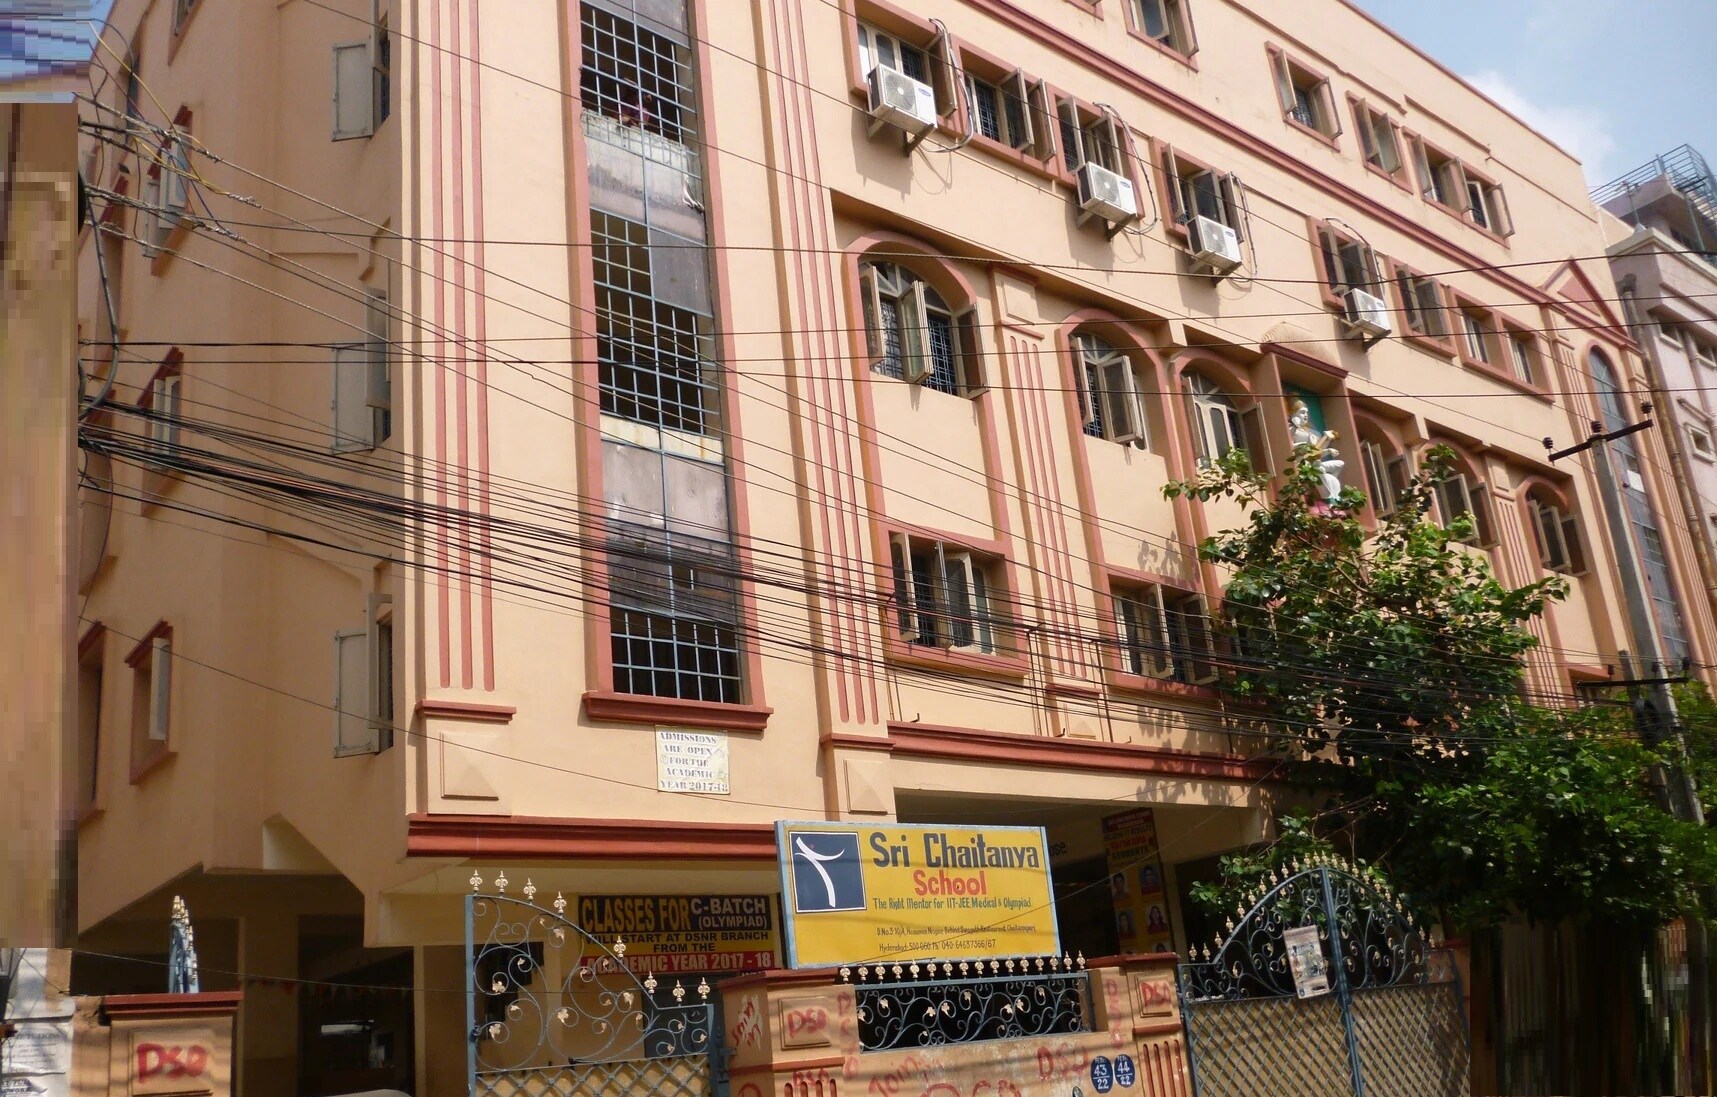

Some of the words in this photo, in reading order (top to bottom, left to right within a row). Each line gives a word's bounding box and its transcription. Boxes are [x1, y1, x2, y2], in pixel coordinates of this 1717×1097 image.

[660, 732, 717, 744] ADMISSIONS
[664, 745, 683, 753] ARE
[687, 746, 713, 756] OPEN
[669, 757, 688, 766] FOR
[667, 768, 713, 779] ACADEMIC
[660, 781, 687, 789] YEAR
[869, 831, 910, 868] Sri
[923, 832, 1040, 869] Chaitanya
[913, 869, 987, 896] School
[873, 897, 888, 910] The
[888, 897, 905, 910] Right
[907, 897, 932, 909] Mentor
[933, 897, 944, 909] for
[971, 896, 998, 908] Medical
[581, 896, 655, 933] CLASSES
[659, 897, 692, 932] FOR
[692, 898, 766, 915] C-BATCH
[698, 915, 768, 930] (OLYMPIAD)
[621, 933, 662, 943] START
[666, 933, 681, 942] AT
[685, 932, 717, 942] DSNR
[721, 931, 769, 941] BRANCH
[653, 943, 689, 953] FROM
[691, 943, 716, 952] THE
[671, 954, 707, 971] YEAR
[710, 953, 745, 970] 2017
[756, 951, 772, 968] 18
[1093, 1064, 1108, 1076] 43
[1117, 1061, 1130, 1074] 44
[1097, 1078, 1110, 1090] 22
[1120, 1075, 1131, 1085] 22
